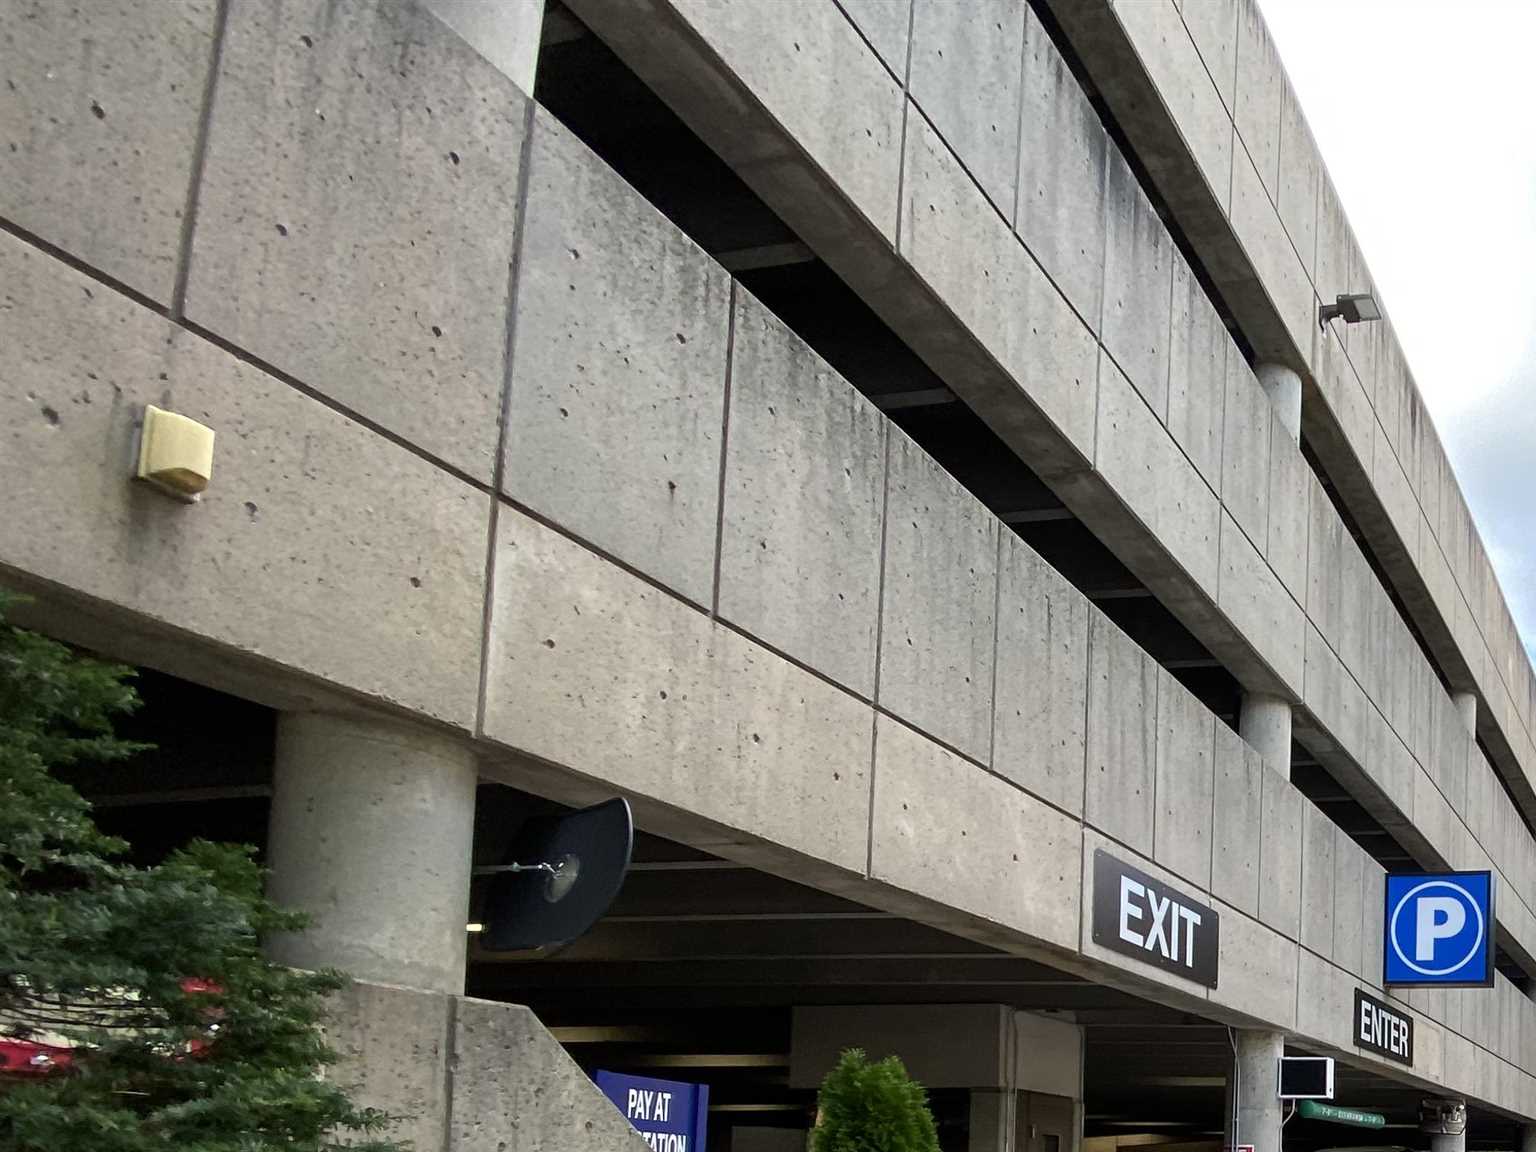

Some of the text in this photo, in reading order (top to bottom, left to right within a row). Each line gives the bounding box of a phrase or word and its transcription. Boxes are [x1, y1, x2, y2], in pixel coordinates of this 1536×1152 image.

[1119, 874, 1202, 969] EXIT
[1415, 896, 1467, 962] P
[1360, 999, 1410, 1058] ENTER
[627, 1088, 672, 1122] PAY AT
